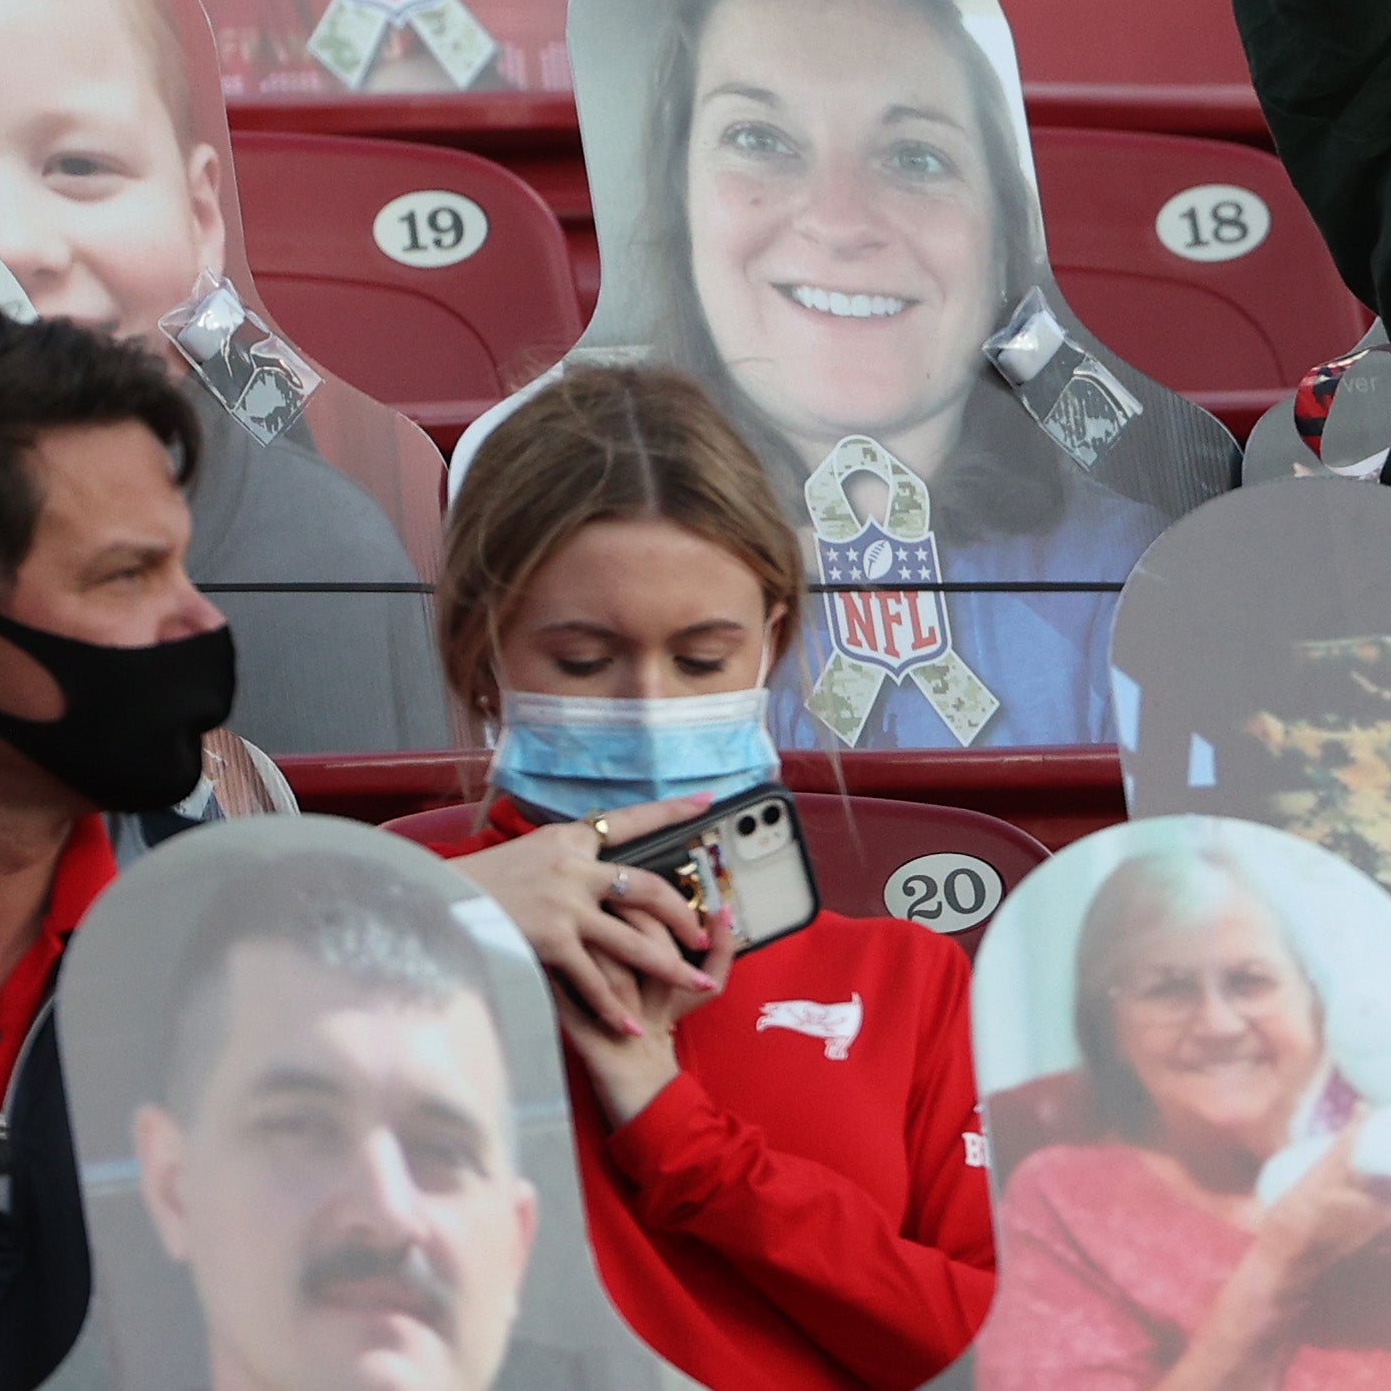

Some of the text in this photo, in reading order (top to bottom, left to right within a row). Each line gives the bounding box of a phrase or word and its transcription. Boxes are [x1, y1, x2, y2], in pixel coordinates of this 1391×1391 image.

[397, 207, 465, 252] 19
[1179, 200, 1249, 249] 18
[838, 590, 938, 660] NFL
[901, 867, 987, 922] 20
